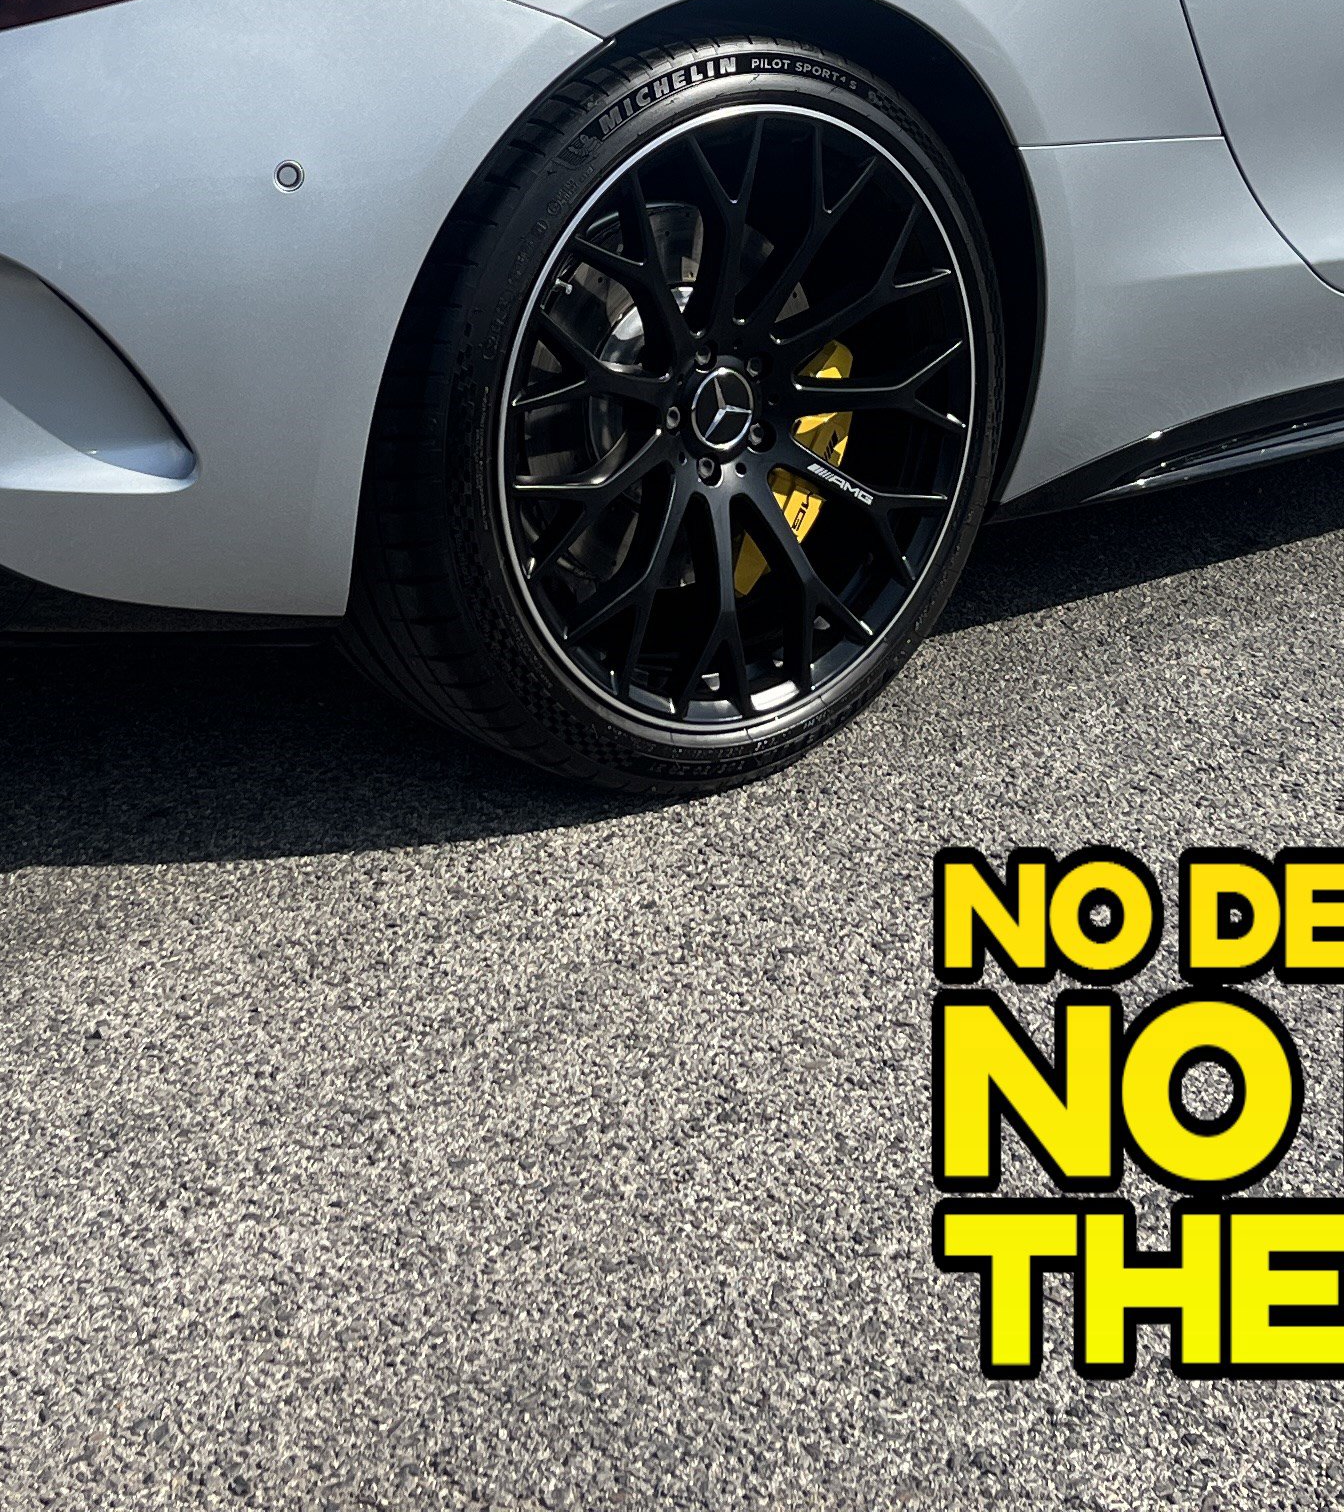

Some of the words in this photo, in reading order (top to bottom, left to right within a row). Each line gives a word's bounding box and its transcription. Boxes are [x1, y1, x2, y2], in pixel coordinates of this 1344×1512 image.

[598, 56, 738, 135] MICHELIN
[751, 58, 791, 70] PILOT
[828, 475, 874, 506] AMG
